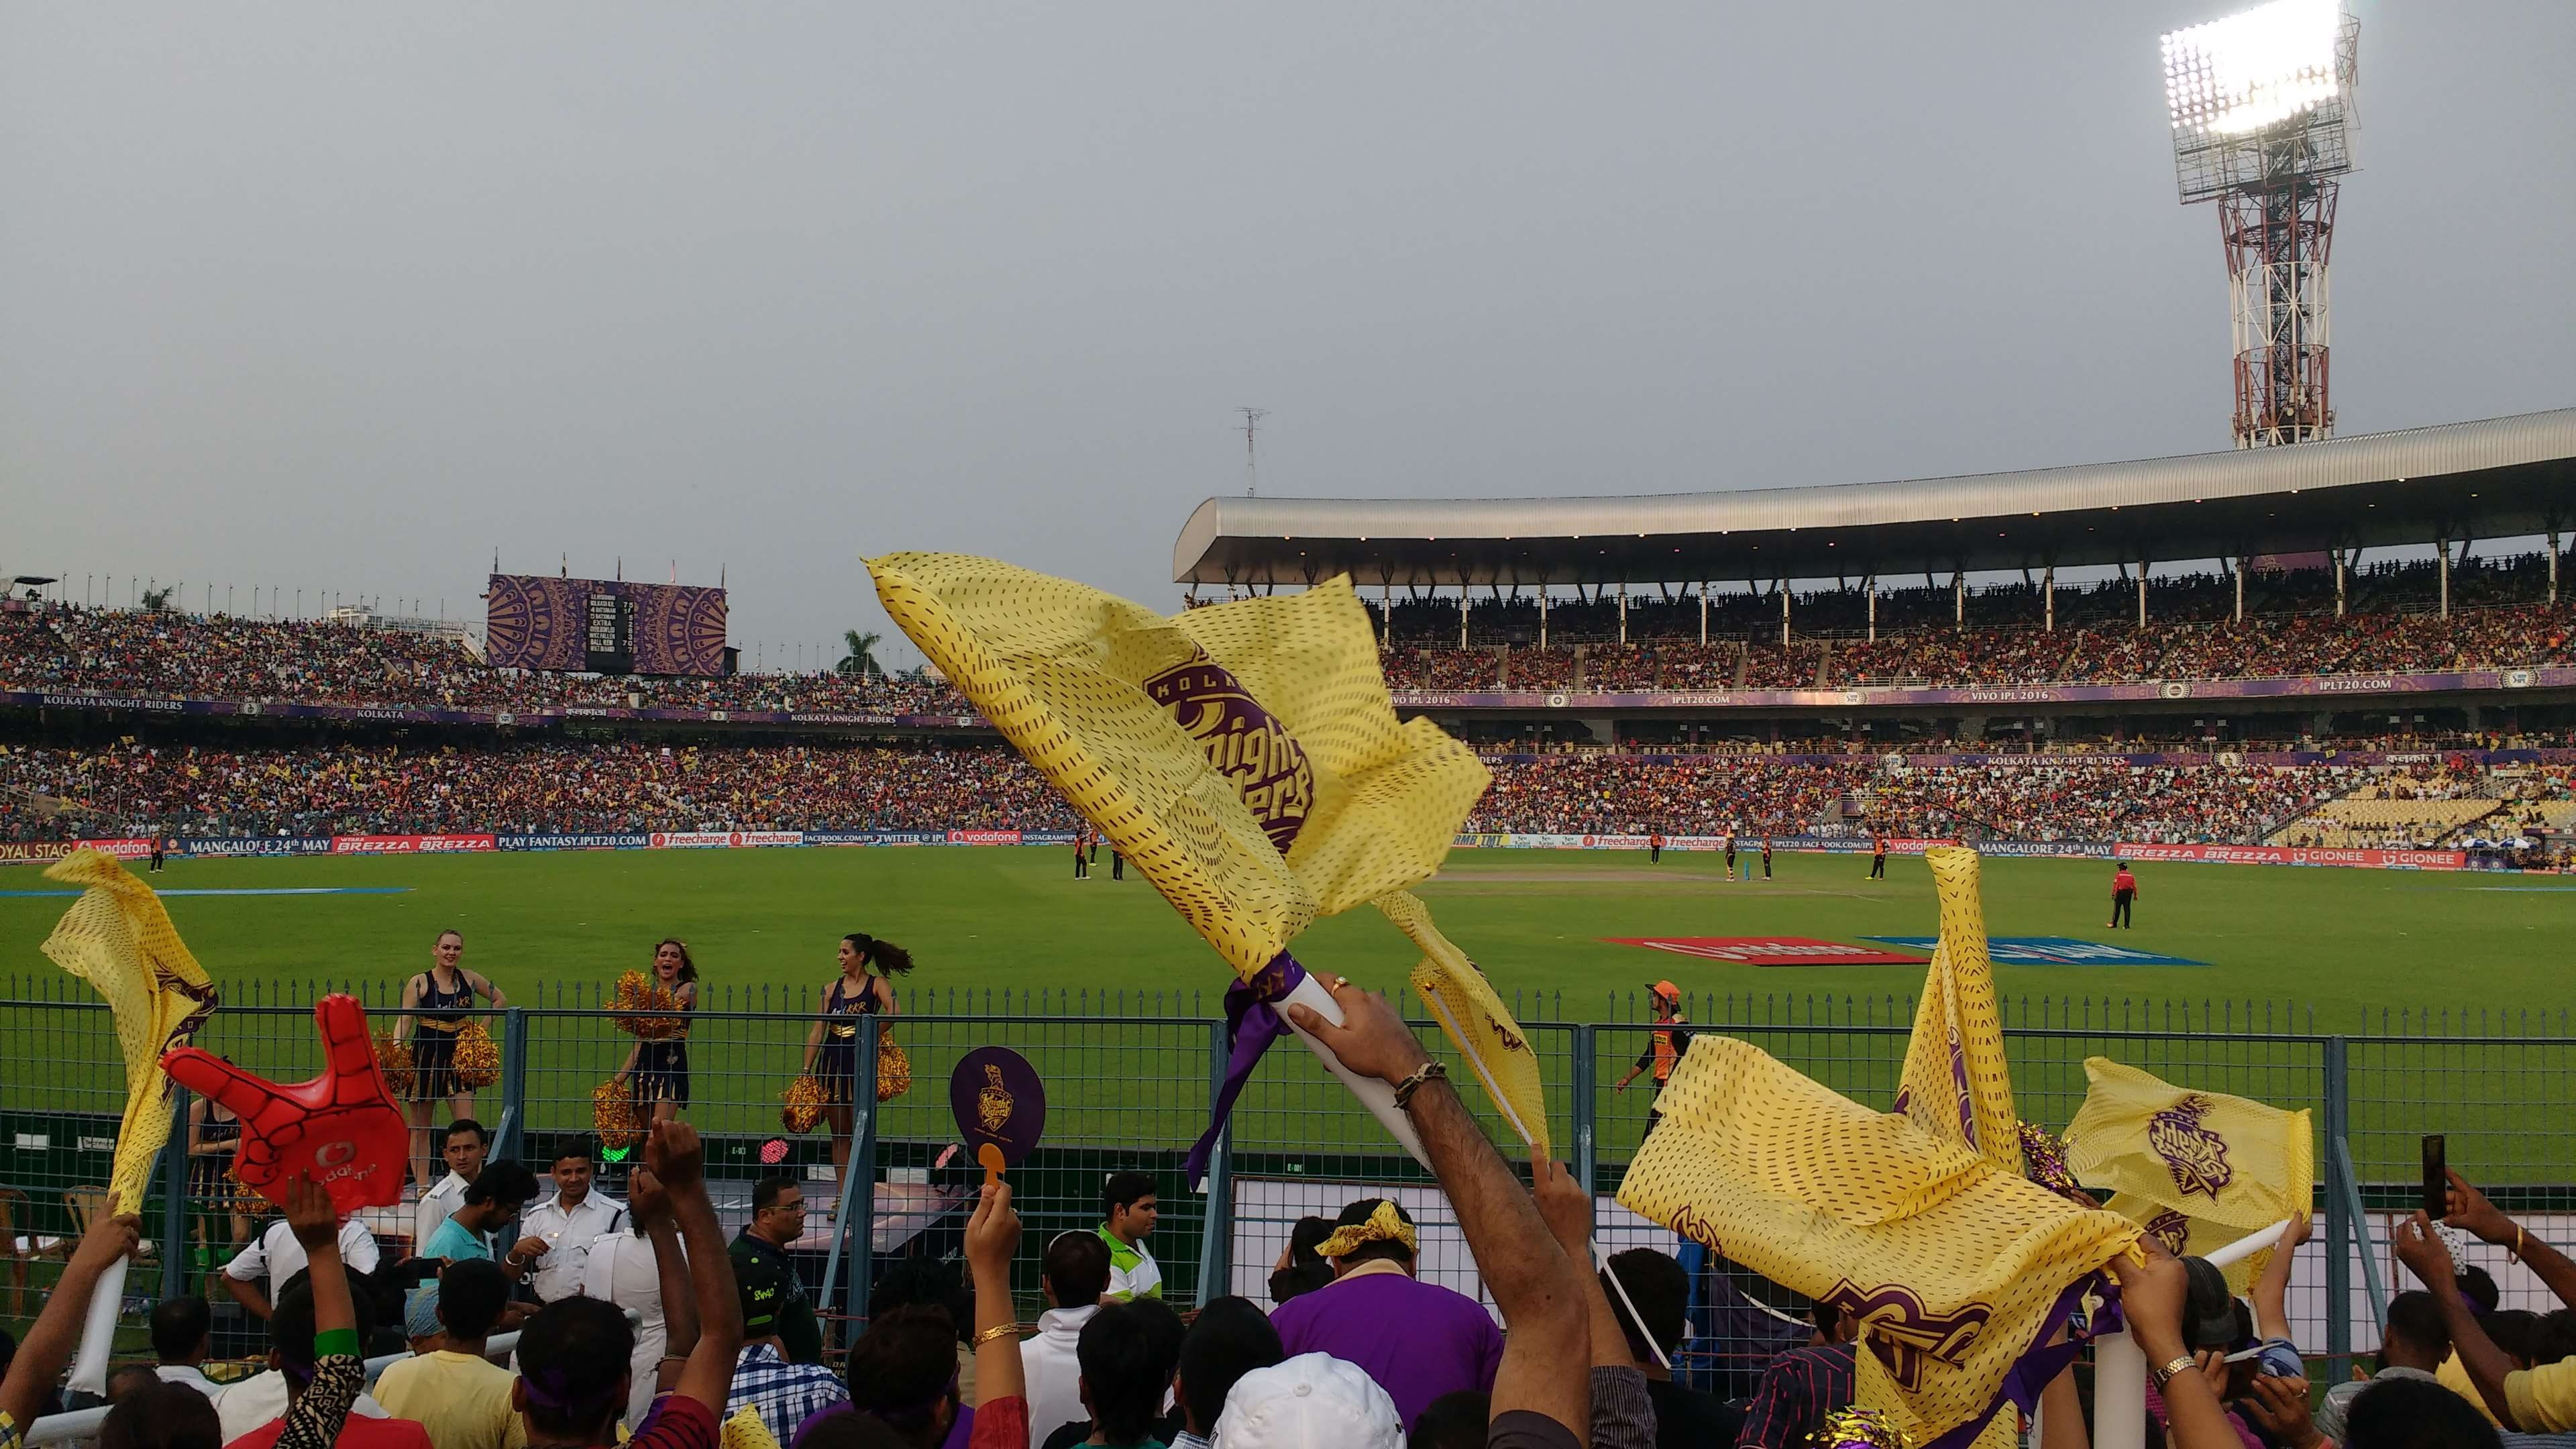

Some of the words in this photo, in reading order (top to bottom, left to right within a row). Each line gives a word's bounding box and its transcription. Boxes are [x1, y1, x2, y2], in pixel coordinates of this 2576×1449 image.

[2319, 679, 2392, 691] IPLT20.COM
[1426, 696, 1450, 704] 2016
[1672, 696, 1730, 704] IPLT20.COM
[1972, 691, 1998, 701] VIVO
[2000, 691, 2017, 700] IPL
[2021, 690, 2049, 700] 2016
[43, 694, 96, 706] KOLKATA
[100, 696, 141, 708] KNIGHT
[145, 699, 183, 710] RIDERS
[357, 708, 405, 719] KOLKATA
[792, 714, 830, 723] KOLKATA
[833, 714, 865, 723] KNIGHT
[867, 715, 896, 724] RIDERS
[1714, 757, 1759, 765] KOKATA
[1988, 757, 2039, 765] KOLKATA
[2042, 757, 2084, 765] KNIGHT
[498, 837, 527, 847] PLAY
[529, 836, 646, 847] FANTASY.IPLT20.COM
[669, 834, 727, 845] freecharge
[745, 833, 802, 844] freecharge
[877, 835, 920, 843] TWITTER
[967, 833, 1018, 842] vodafone
[1453, 835, 1478, 845] RMB
[1599, 836, 1652, 847] freecharge
[1670, 836, 1725, 847] freecharge
[35, 844, 70, 858] STAG
[95, 841, 151, 854] vodafon
[276, 839, 299, 852] 24th
[303, 839, 330, 851] MAY
[337, 841, 411, 851] BREZZA
[419, 840, 490, 850] BREZZA
[1979, 843, 2055, 854] MANGALORE
[2057, 843, 2081, 854] 24th
[2084, 845, 2111, 855] MAY
[2118, 849, 2196, 858] BREZZA
[2204, 850, 2282, 861] BREZZA
[2310, 850, 2365, 862] GIONEE
[2400, 853, 2455, 865] GIONEE
[981, 1093, 1011, 1109] Knight
[979, 1104, 1010, 1118] Riders
